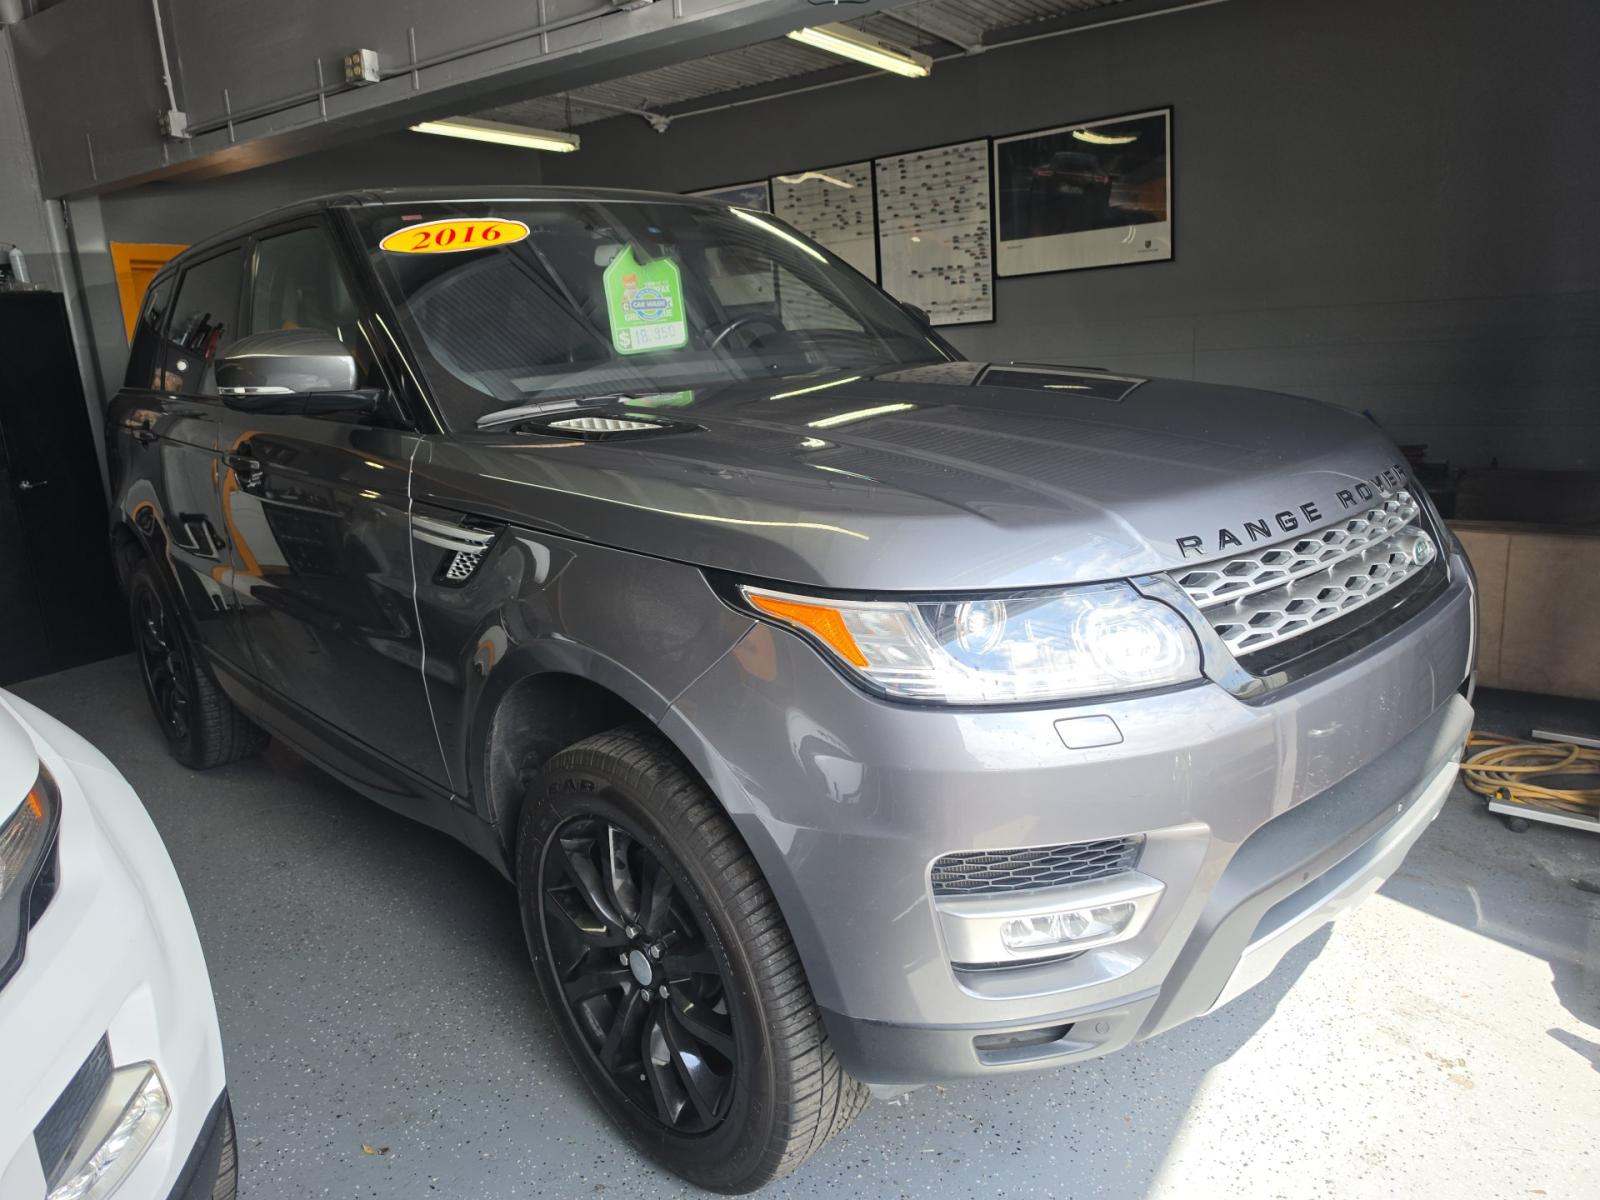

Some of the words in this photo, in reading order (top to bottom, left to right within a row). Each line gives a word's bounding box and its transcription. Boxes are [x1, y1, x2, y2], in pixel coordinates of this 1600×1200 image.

[410, 224, 501, 251] 2016
[1176, 502, 1322, 558] RANGE
[1336, 464, 1407, 510] ROVER
